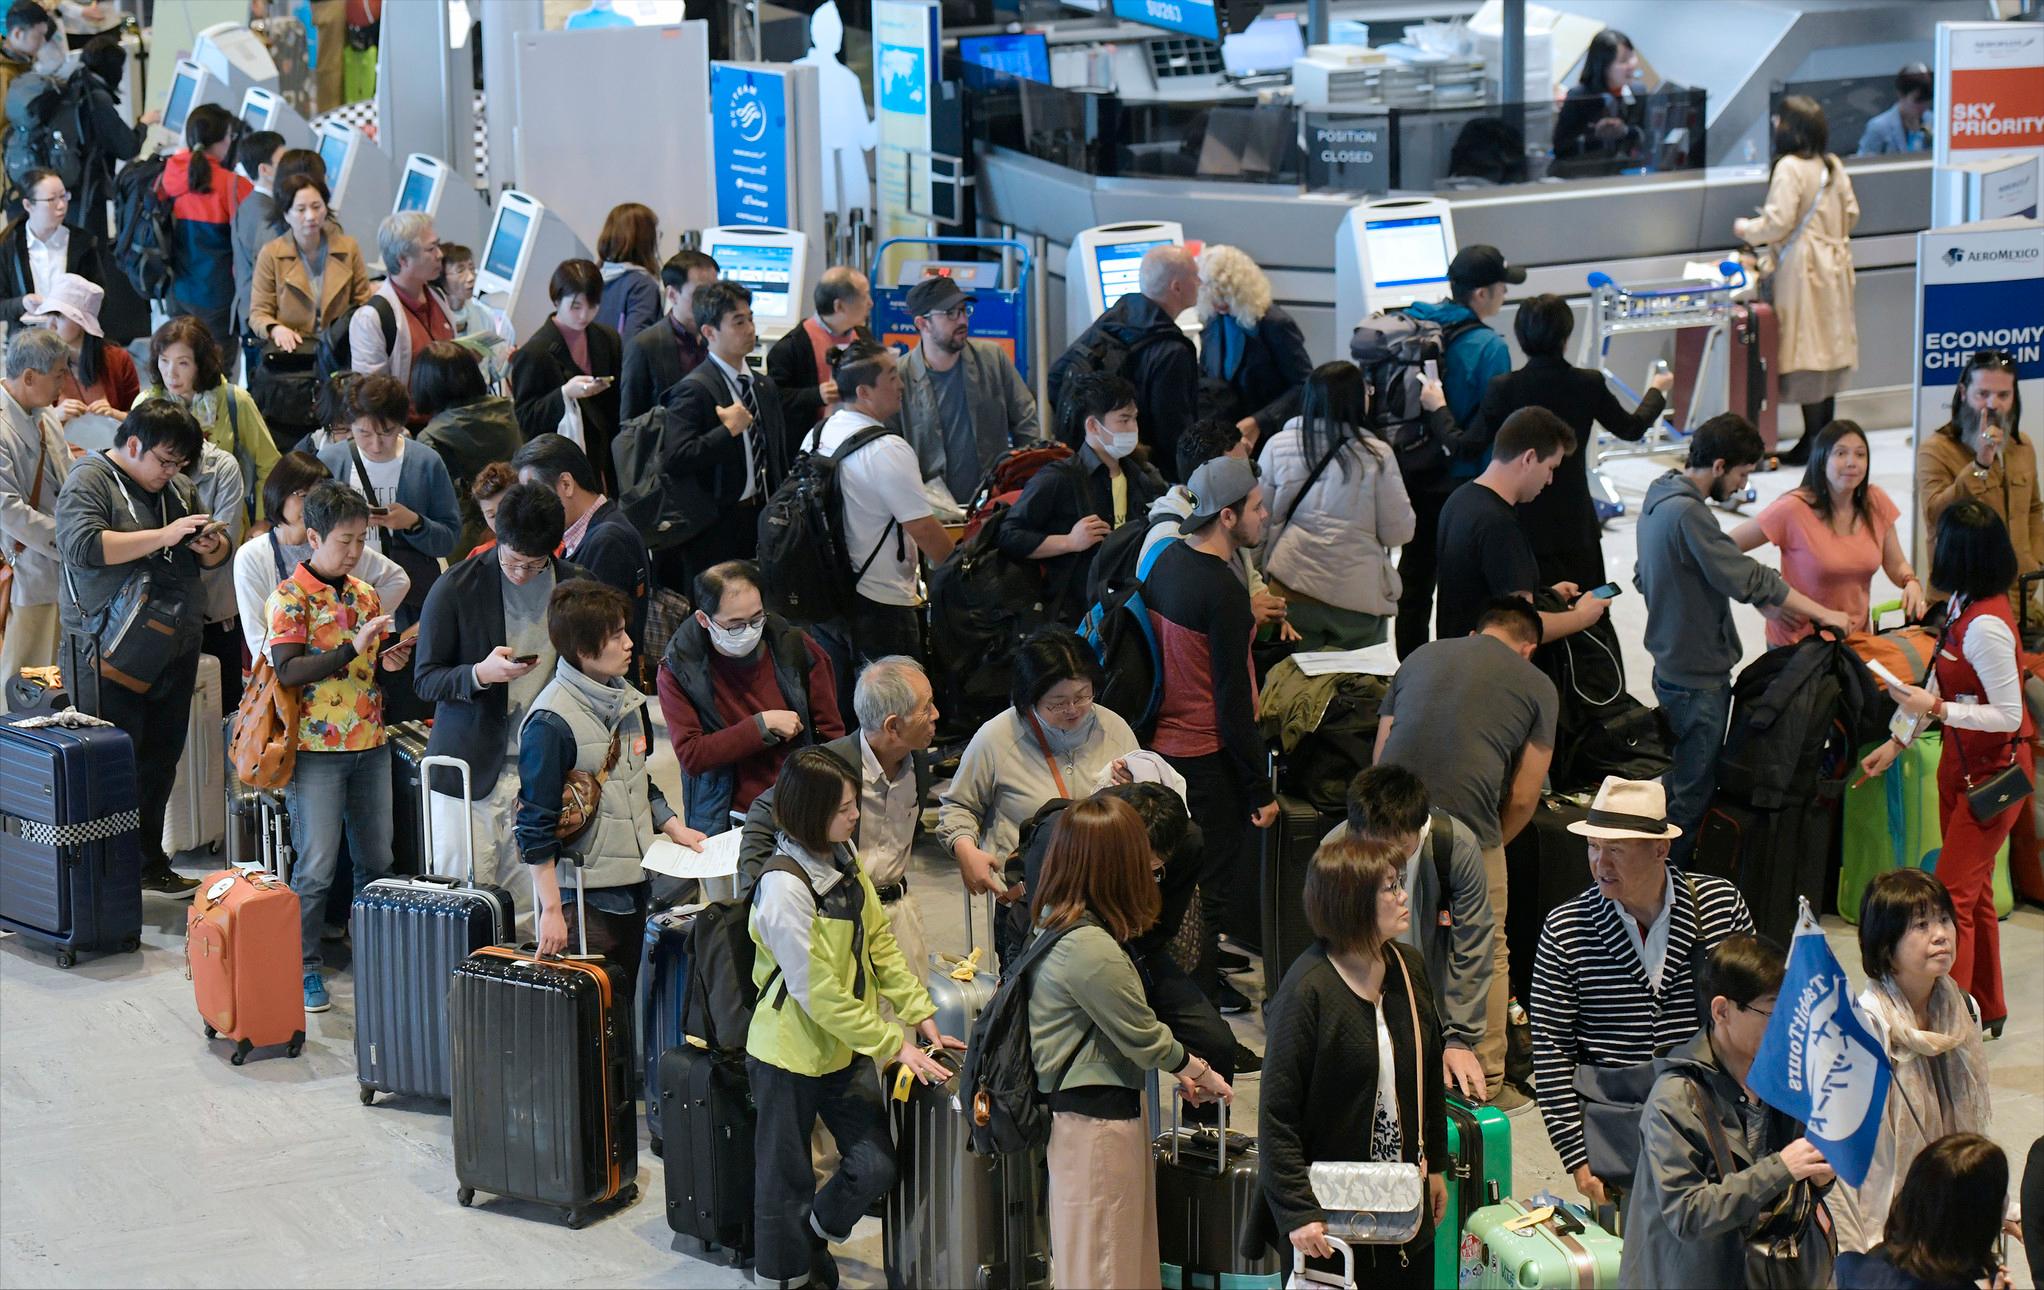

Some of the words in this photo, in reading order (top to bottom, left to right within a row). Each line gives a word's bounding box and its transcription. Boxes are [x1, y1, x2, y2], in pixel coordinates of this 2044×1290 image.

[1953, 103, 1995, 120] SKY
[1952, 116, 2044, 136] PRIORITY
[1317, 130, 1377, 143] POSITION
[1321, 150, 1374, 163] CLOSED
[1925, 326, 2044, 350] ECONOMY
[1925, 346, 2040, 369] CHE-IN
